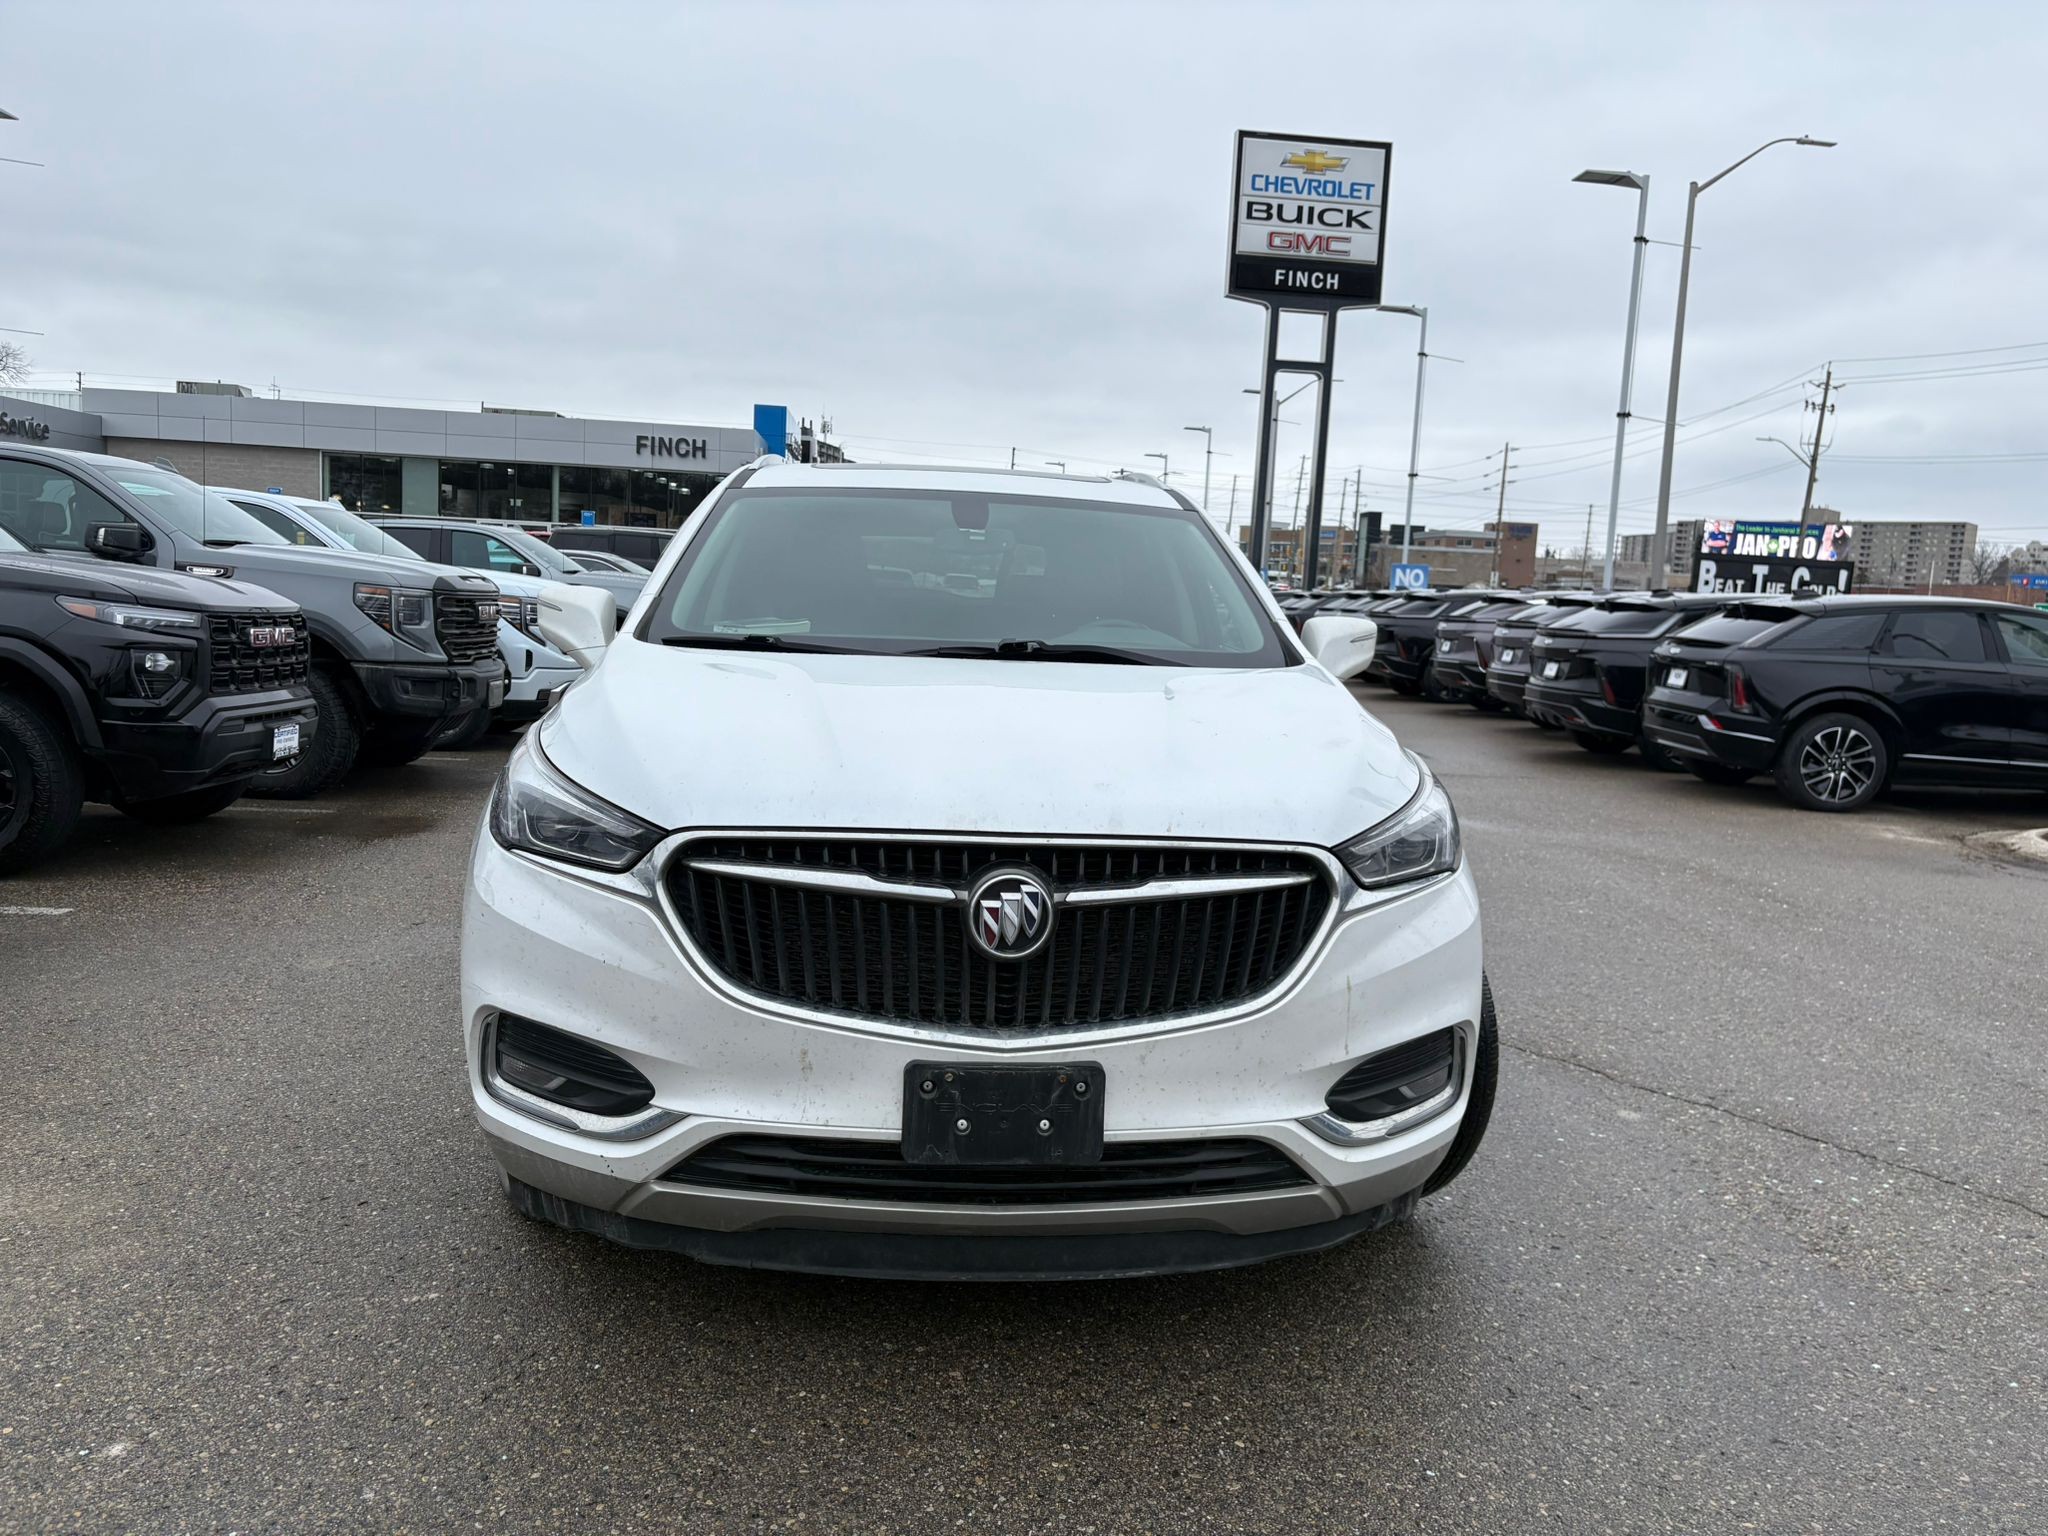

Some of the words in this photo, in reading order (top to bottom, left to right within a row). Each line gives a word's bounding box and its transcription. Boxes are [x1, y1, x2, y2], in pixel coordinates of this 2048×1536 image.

[1251, 174, 1375, 200] CHEVROLET
[1246, 201, 1373, 230] BUICK
[1267, 231, 1351, 257] GMC
[1274, 269, 1339, 290] FINCH
[0, 411, 50, 440] Service
[636, 435, 706, 459] FINCH
[1733, 533, 1770, 557] JAN
[1395, 567, 1424, 588] NO
[1697, 559, 1745, 594] BEAT
[1752, 564, 1785, 594] THE
[250, 627, 295, 647] GMC
